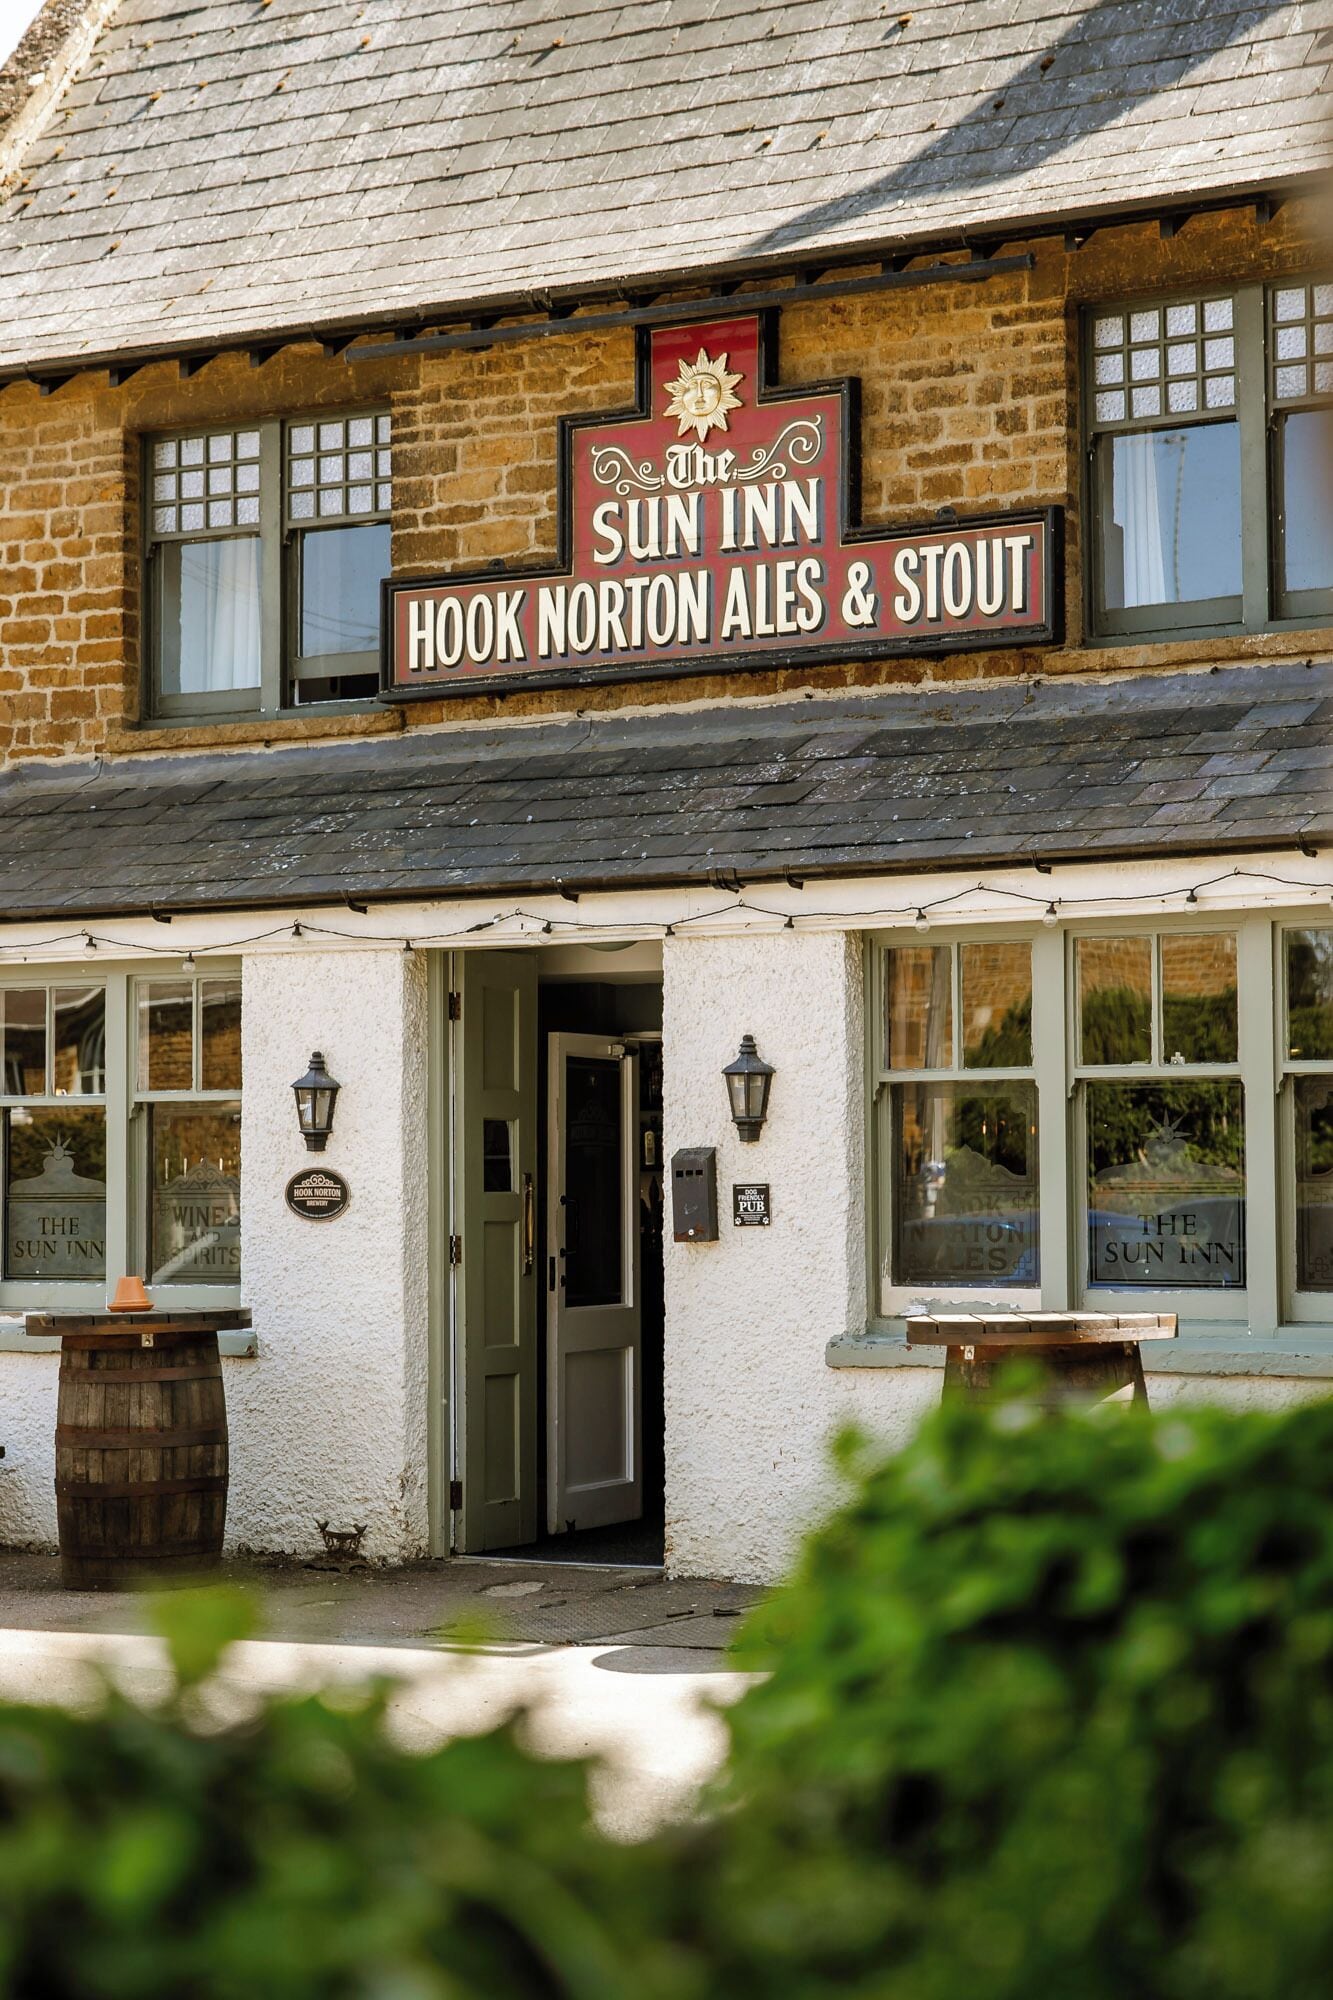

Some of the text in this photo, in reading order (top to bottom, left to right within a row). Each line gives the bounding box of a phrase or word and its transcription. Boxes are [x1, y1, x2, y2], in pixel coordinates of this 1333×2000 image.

[665, 442, 736, 489] The
[592, 477, 820, 565] SUN INN
[408, 535, 1033, 670] HOOK NORTON ALES & STOUT
[293, 1188, 341, 1197] HOOK NORTON
[172, 1206, 241, 1228] WINES
[739, 1201, 765, 1212] PUB
[38, 1217, 80, 1235] THE
[910, 1220, 1025, 1243] NRTON
[1137, 1214, 1198, 1236] THE
[15, 1240, 105, 1258] SUN INN
[1104, 1242, 1236, 1264] SUN INN
